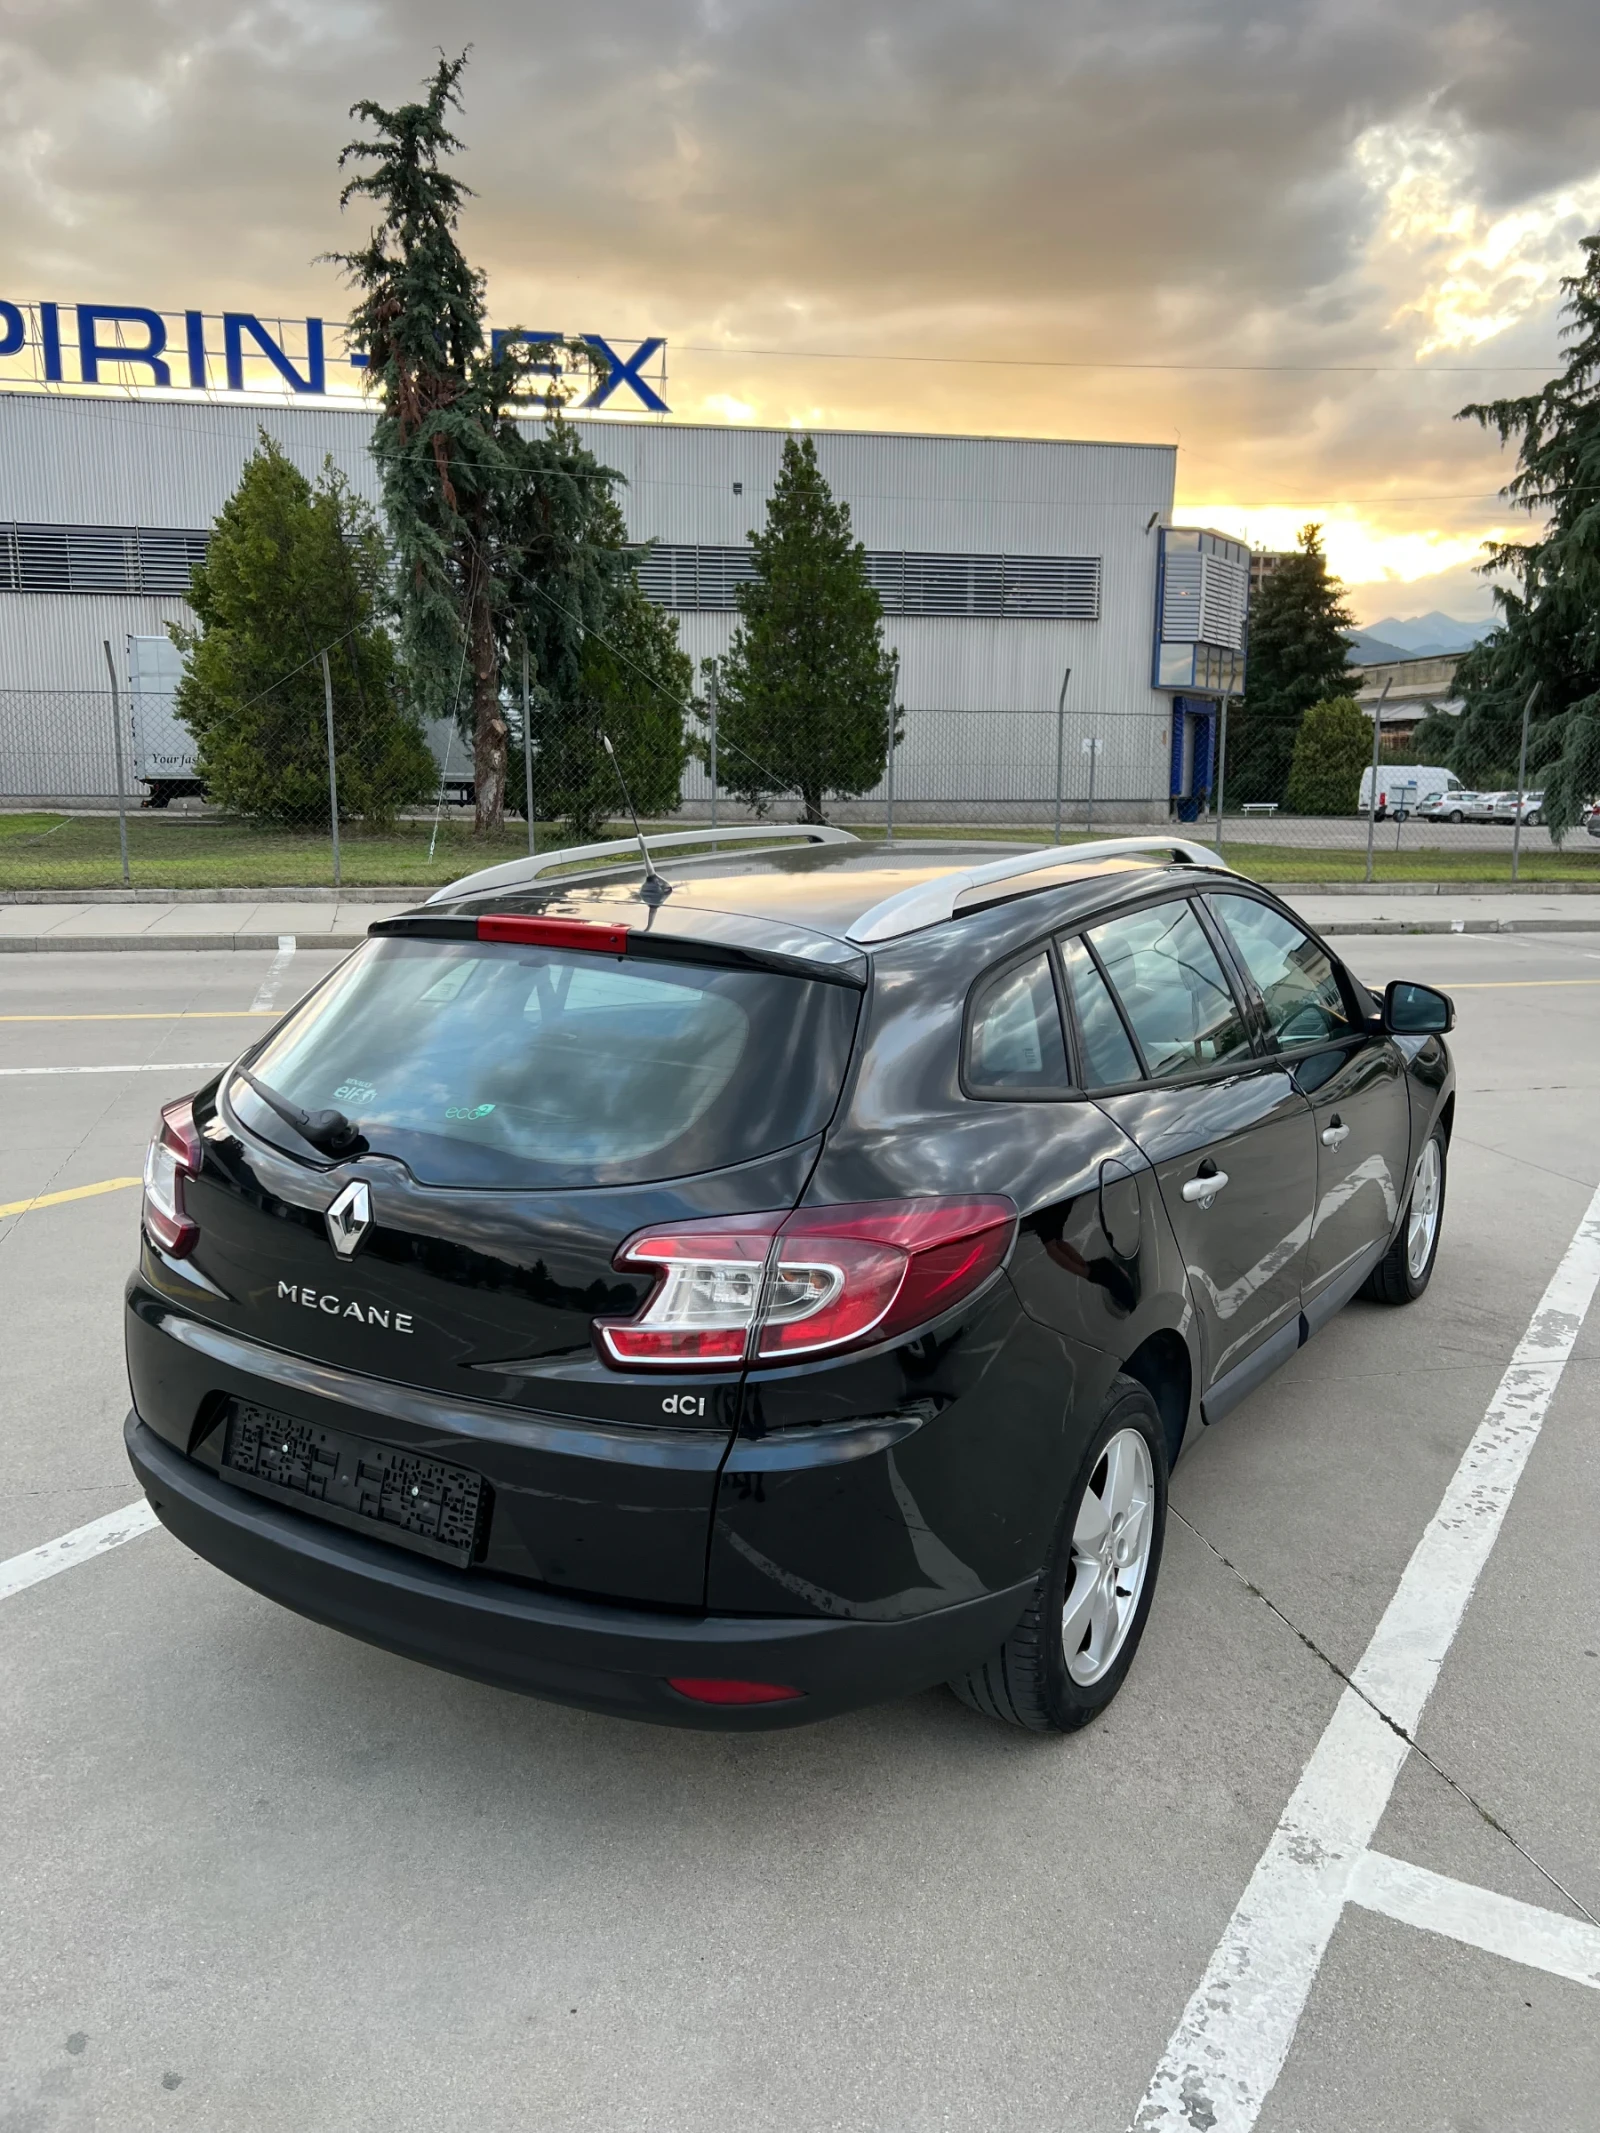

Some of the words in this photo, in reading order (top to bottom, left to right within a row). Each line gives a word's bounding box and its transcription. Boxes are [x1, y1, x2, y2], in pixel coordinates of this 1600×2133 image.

[0, 300, 672, 413] IRIN-EX
[152, 753, 180, 764] Your
[178, 752, 201, 768] fas
[277, 1280, 414, 1334] MEGANE
